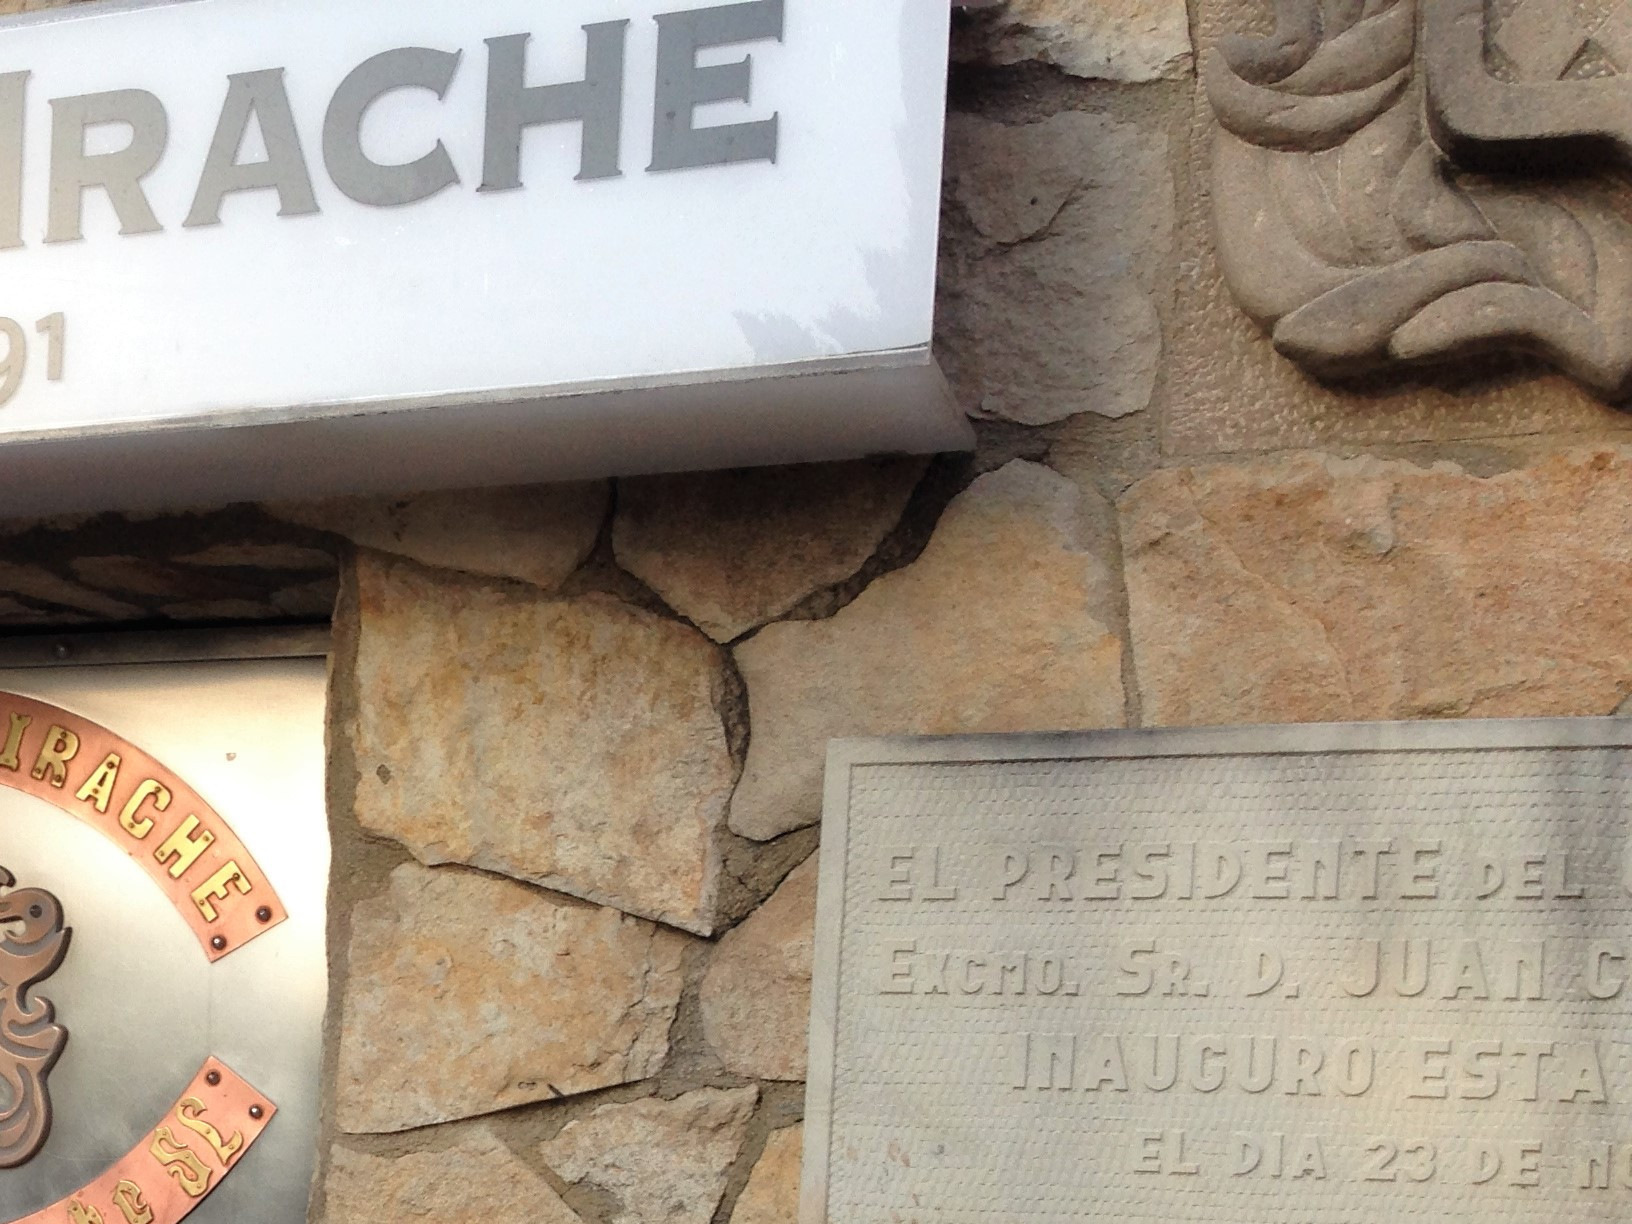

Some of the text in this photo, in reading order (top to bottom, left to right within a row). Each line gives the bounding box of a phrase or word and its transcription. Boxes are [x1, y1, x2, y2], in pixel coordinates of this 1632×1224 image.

[877, 846, 958, 901] EL
[992, 840, 1443, 901] PRESIDENTE
[1475, 853, 1585, 901] DEL
[1246, 940, 1300, 998] D.
[1343, 938, 1546, 1001] JUAN
[1406, 1037, 1609, 1104] ESTA
[1133, 1129, 1200, 1176] EL
[1232, 1131, 1327, 1180] DIA
[1364, 1138, 1436, 1183] 23
[1472, 1142, 1542, 1188] DE
